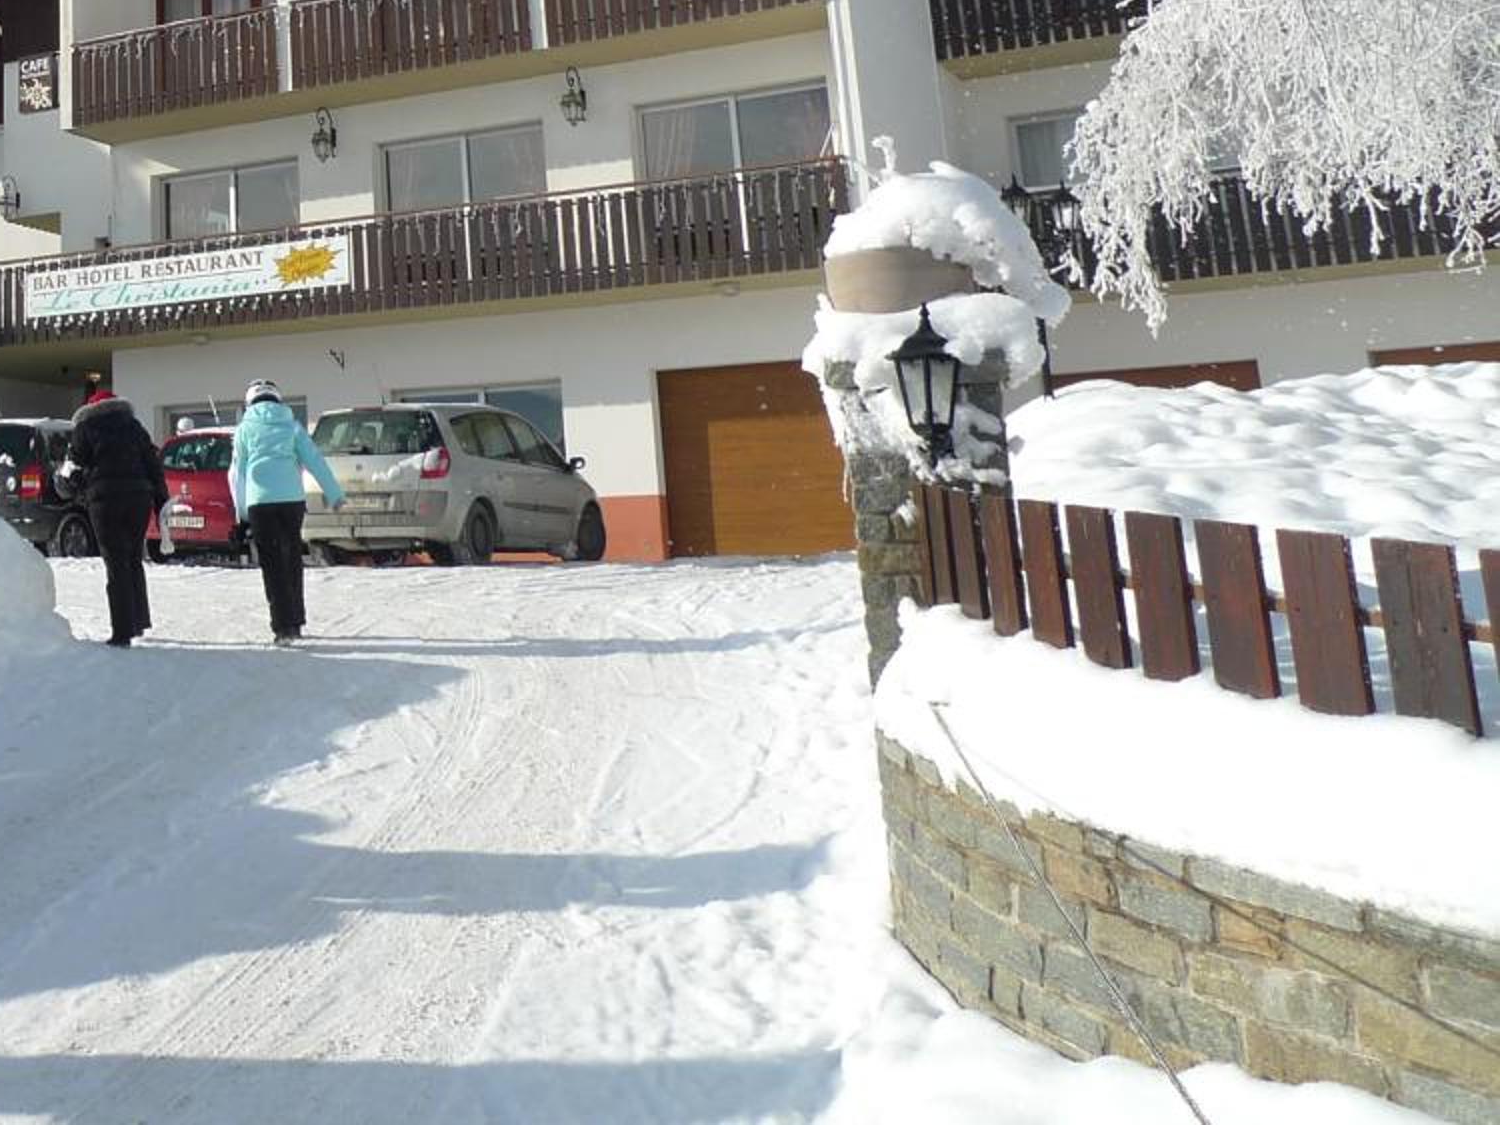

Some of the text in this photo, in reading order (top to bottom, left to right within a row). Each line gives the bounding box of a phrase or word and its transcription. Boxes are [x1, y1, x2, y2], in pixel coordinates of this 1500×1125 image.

[32, 274, 68, 291] BAR
[141, 250, 265, 279] RESTAURANT
[89, 279, 253, 309] Christania
